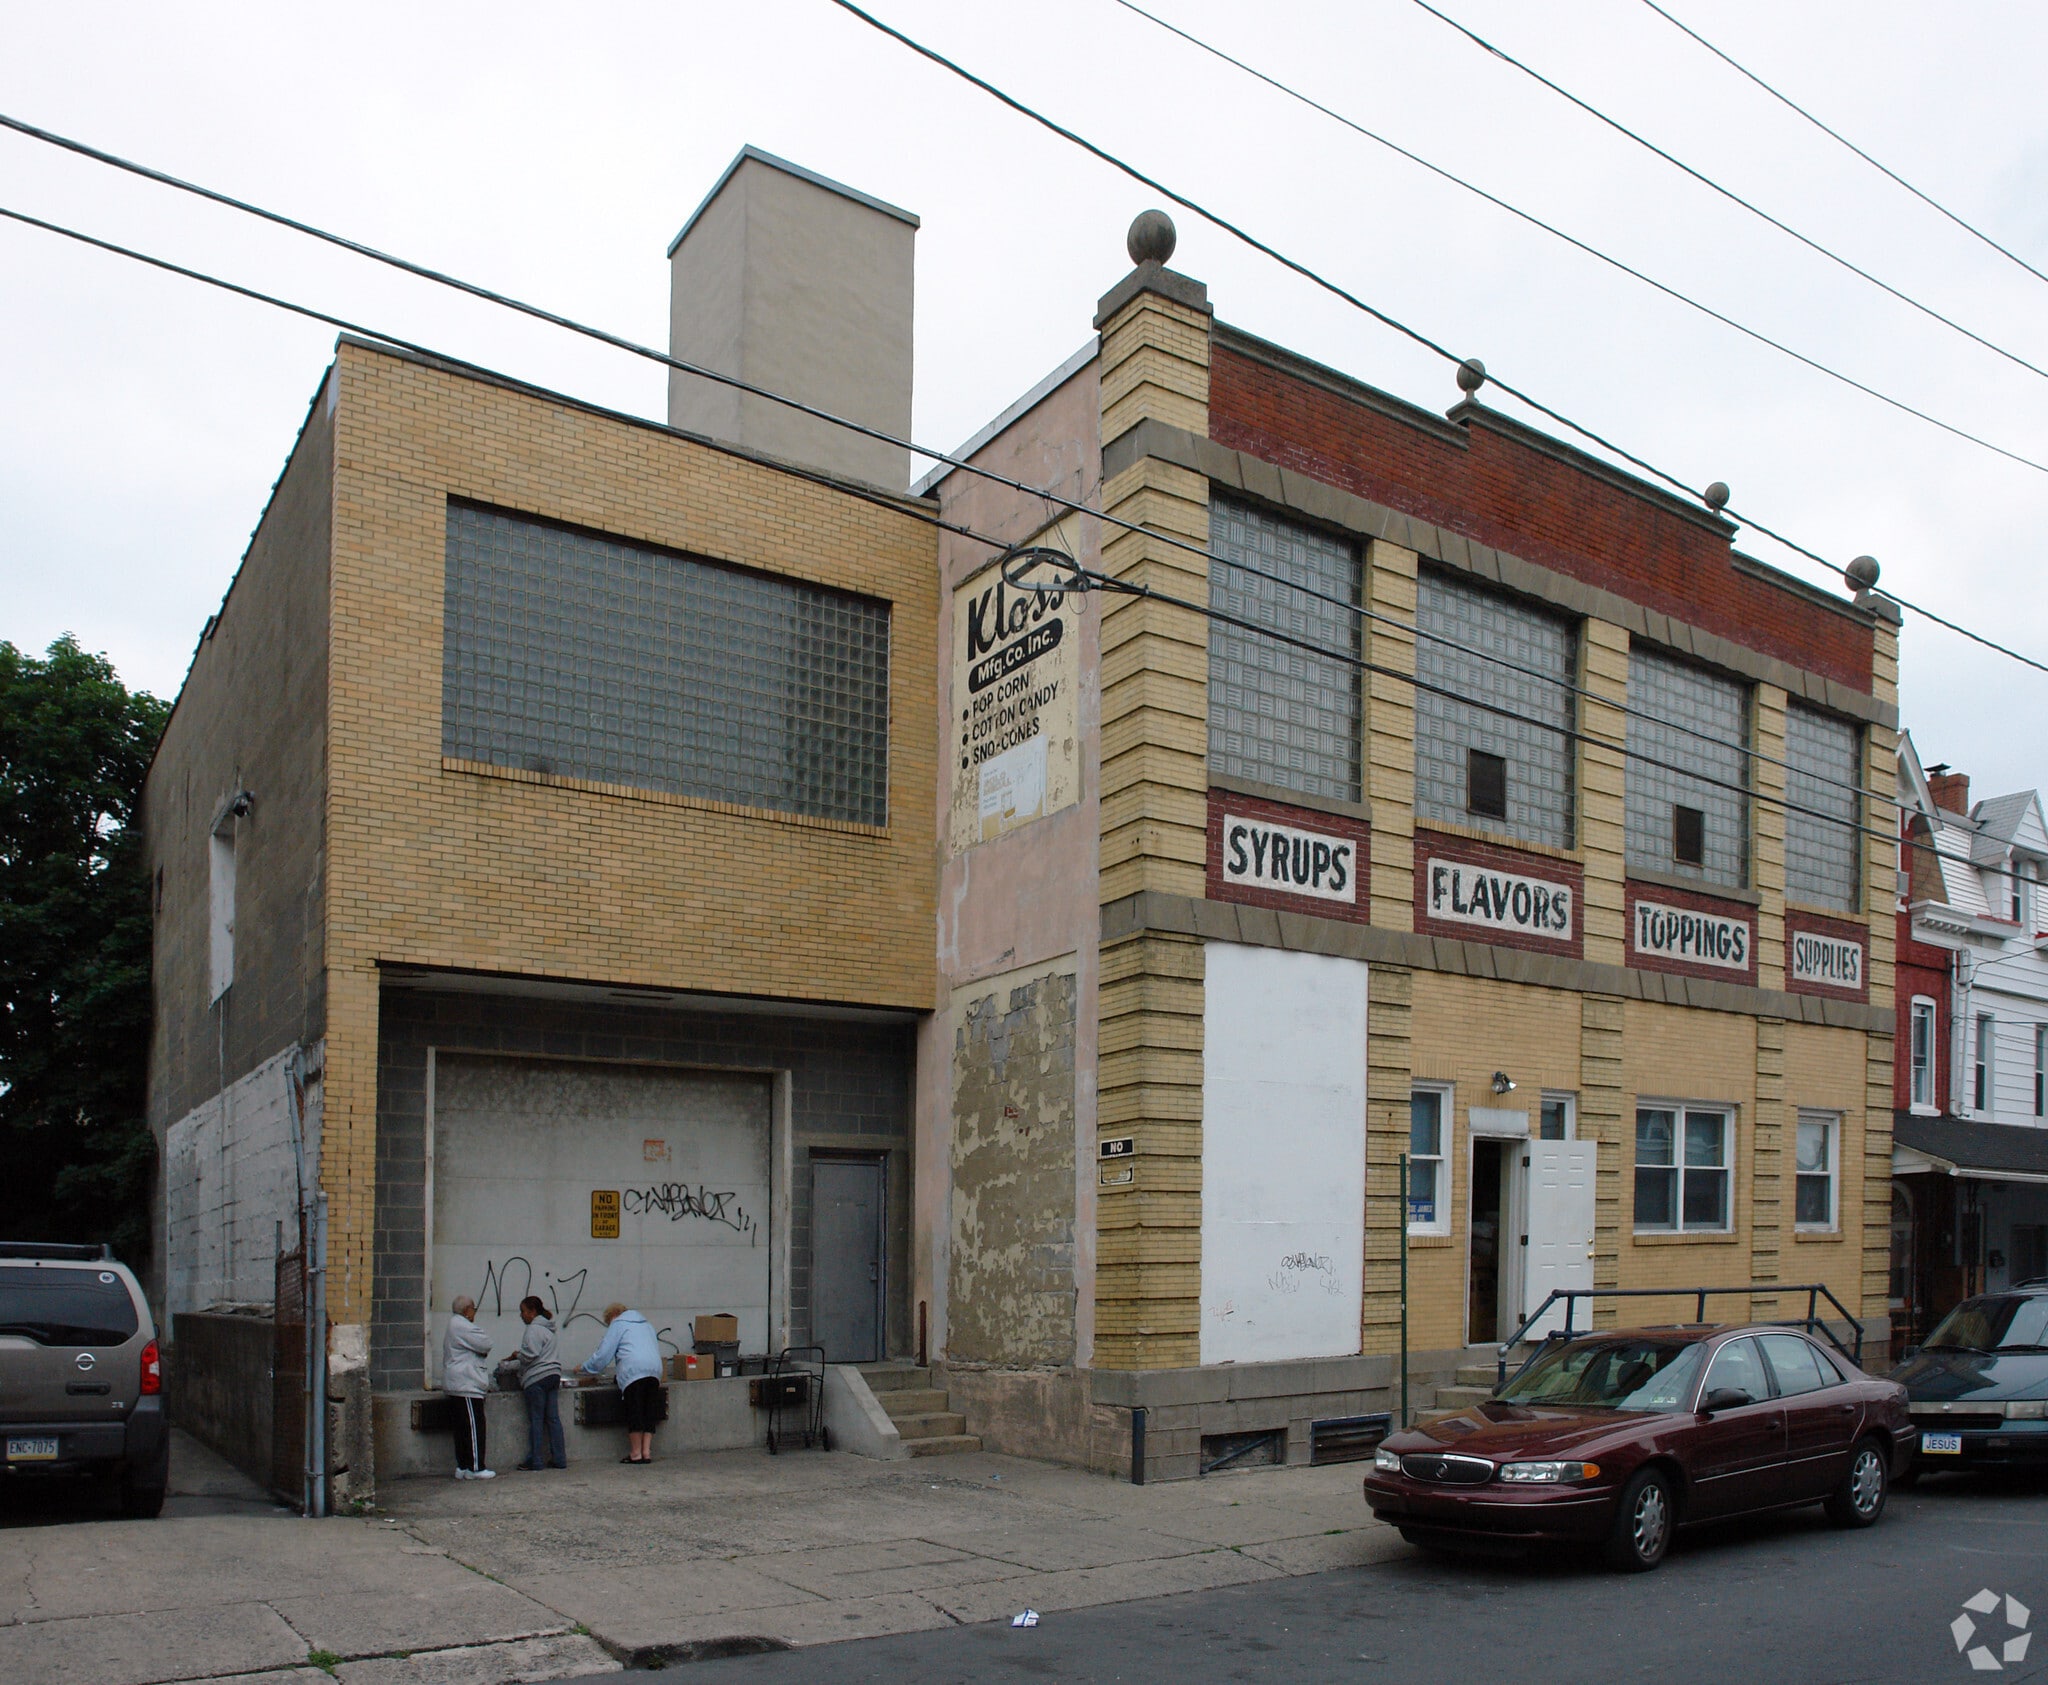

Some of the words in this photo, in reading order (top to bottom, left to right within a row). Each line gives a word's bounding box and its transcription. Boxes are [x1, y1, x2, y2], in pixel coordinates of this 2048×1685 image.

[968, 574, 1064, 662] Kloss
[972, 704, 1015, 741] COTTON
[1019, 680, 1059, 717] CANDY
[973, 691, 993, 718] POP
[997, 671, 1029, 703] CORN
[973, 716, 1040, 765] SNO-CONES
[1228, 825, 1351, 892] SYRUPS
[1432, 866, 1568, 931] FLAVORS
[1639, 905, 1746, 963] TOPPINGS
[1796, 936, 1859, 982] SUPPLIES
[1110, 1141, 1123, 1153] NO
[600, 1195, 612, 1203] NO
[1926, 1439, 1957, 1450] JESUS
